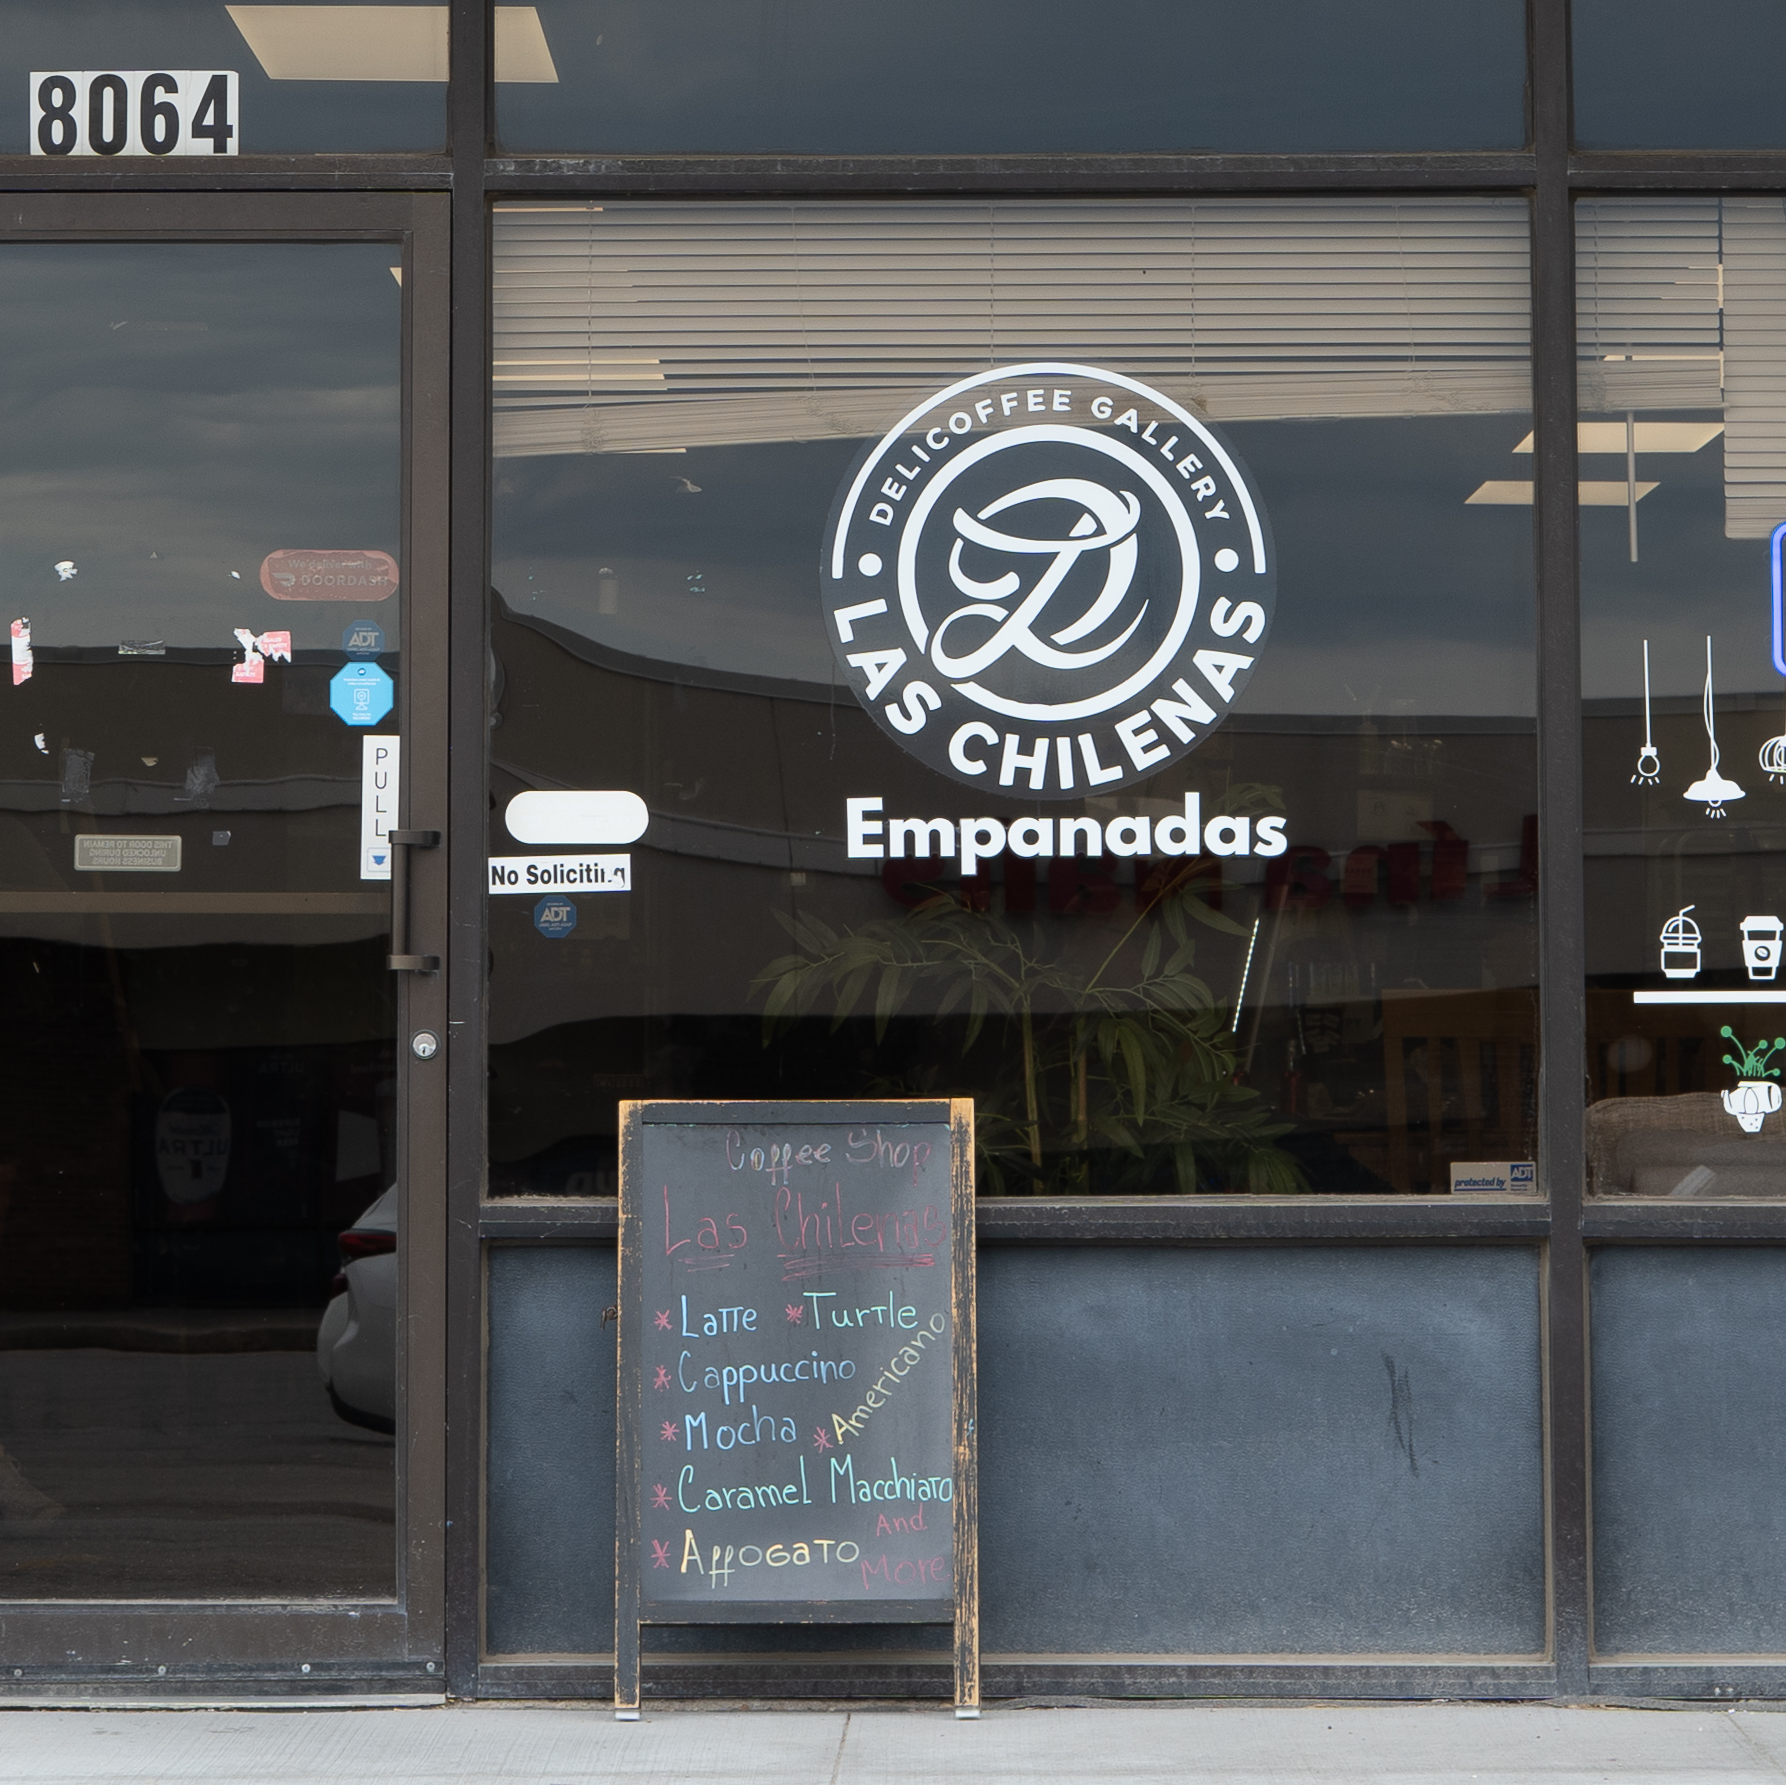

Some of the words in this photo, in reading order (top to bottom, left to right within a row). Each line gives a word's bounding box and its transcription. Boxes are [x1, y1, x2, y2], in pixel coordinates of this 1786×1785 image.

[37, 72, 234, 156] 8064
[868, 388, 1072, 527] DELICOFFEE
[1089, 395, 1230, 523] GALLERY
[301, 574, 388, 587] DOORDASH
[348, 631, 380, 647] ADT
[833, 597, 943, 735] LAS
[948, 595, 1267, 791] CHILENAS
[375, 747, 388, 837] PULL
[845, 792, 1288, 876] Empanadas
[491, 866, 519, 886] No
[540, 906, 571, 922] ADT
[725, 1129, 832, 1186] Coffee
[845, 1129, 932, 1187] Shop
[1454, 1177, 1495, 1188] protected
[1496, 1176, 1506, 1188] by
[1511, 1167, 1532, 1179] ADT
[664, 1184, 748, 1256] Las
[678, 1350, 856, 1405] Cappuccino
[831, 1312, 946, 1445] Americano
[684, 1404, 797, 1451] Mocha
[830, 1453, 953, 1505] Macchiato
[876, 1503, 928, 1537] And
[860, 1555, 951, 1591] More
